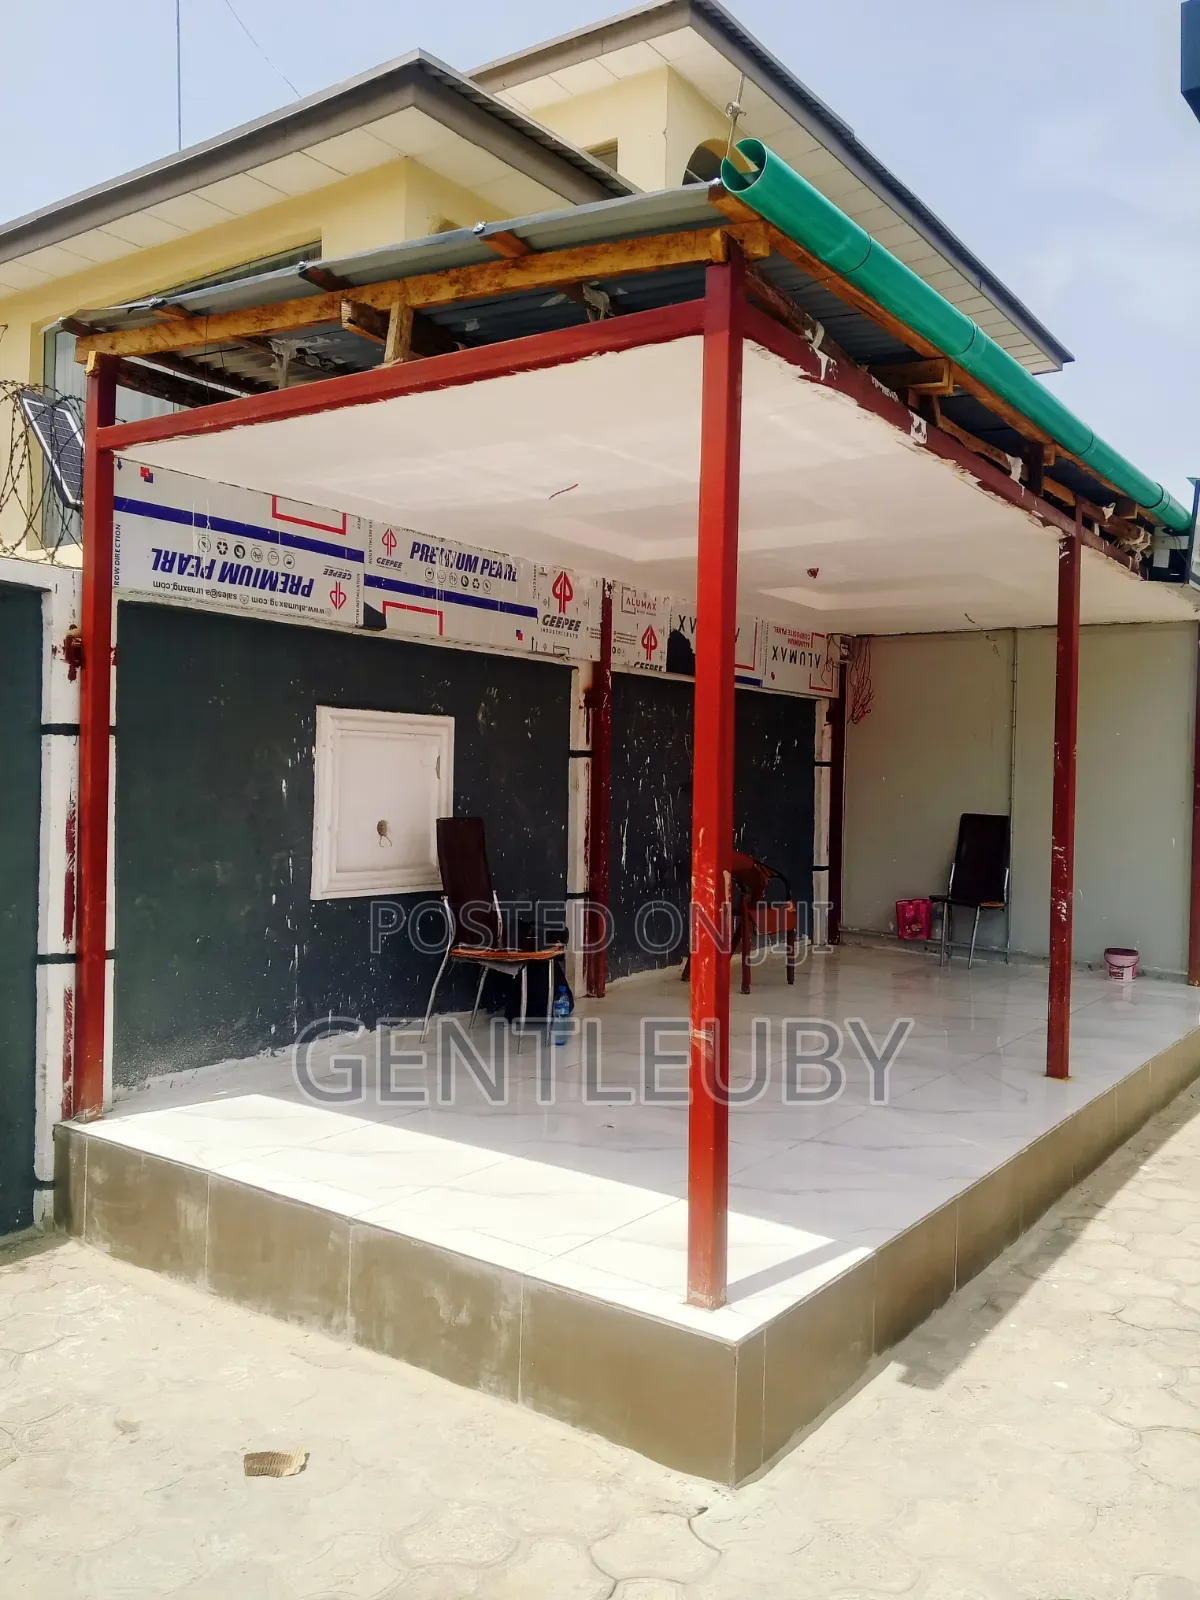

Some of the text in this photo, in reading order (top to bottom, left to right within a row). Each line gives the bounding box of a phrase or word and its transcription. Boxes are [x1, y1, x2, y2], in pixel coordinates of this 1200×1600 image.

[376, 557, 402, 569] GEEPEE
[151, 548, 314, 597] PREMIUM PEARL
[323, 568, 352, 580] GEEPEE
[625, 597, 657, 612] ALUMAX
[542, 613, 581, 632] GEEPEE
[771, 645, 821, 668] ALUMAX
